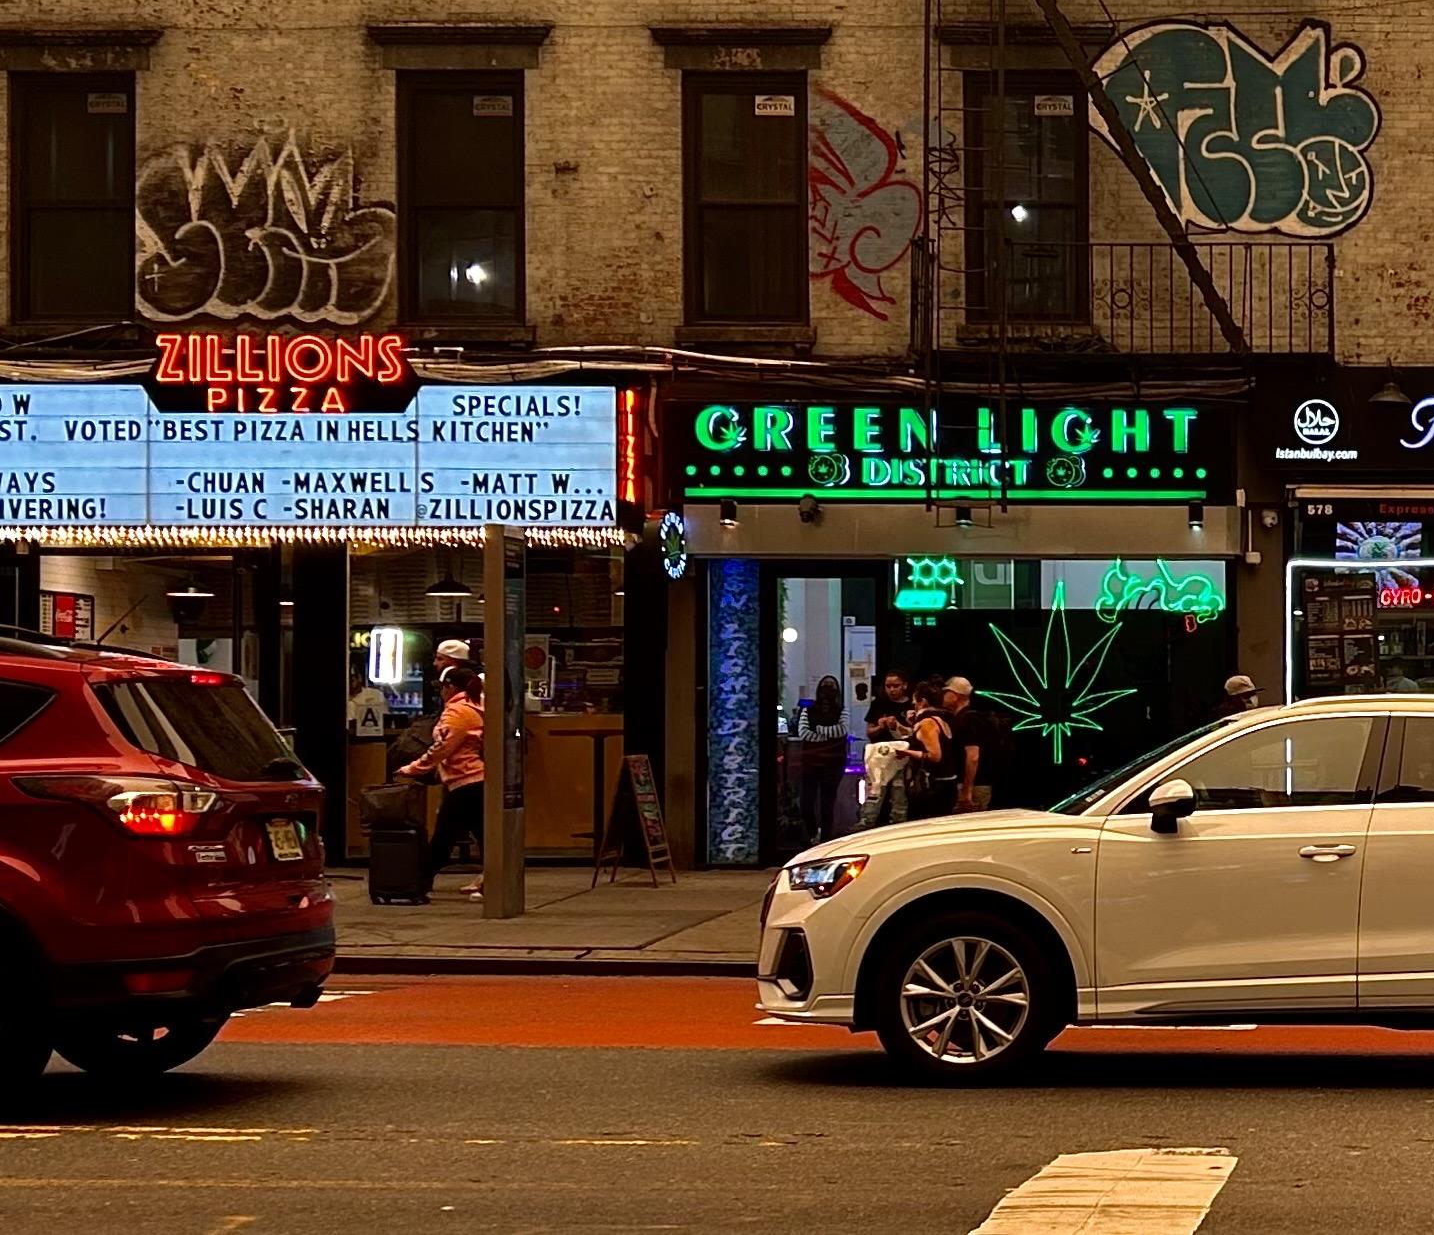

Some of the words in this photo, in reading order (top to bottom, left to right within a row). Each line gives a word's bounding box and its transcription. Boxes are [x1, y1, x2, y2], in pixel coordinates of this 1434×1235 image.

[155, 334, 402, 382] ZILLIONS
[207, 387, 344, 413] PIZZA
[452, 395, 581, 417] SPECIALS!
[1297, 407, 1336, 428] حلال
[64, 420, 141, 441] VOTED
[233, 420, 304, 441] PIZZA
[317, 420, 338, 441] IN
[348, 420, 419, 442] HELLS
[695, 406, 937, 453] GREEN
[977, 405, 1197, 453] LIGHT
[625, 389, 636, 503] PIZZA
[1275, 447, 1358, 462] Istanbulbay.com
[0, 472, 55, 494] AYS
[176, 472, 265, 493] -CHUAN
[282, 472, 412, 493] -MAXWELL
[460, 472, 537, 494] -MATT
[551, 473, 603, 494] W...
[862, 458, 1030, 487] DISTRICT
[176, 498, 243, 520] -LUIS
[253, 498, 267, 519] C
[283, 498, 389, 520] -SHARAN
[417, 498, 615, 521] @ZILLIONSPIZZA
[1307, 504, 1333, 515] 578
[1379, 504, 1434, 516] Express
[1380, 588, 1421, 605] GYRO
[361, 707, 379, 727] A
